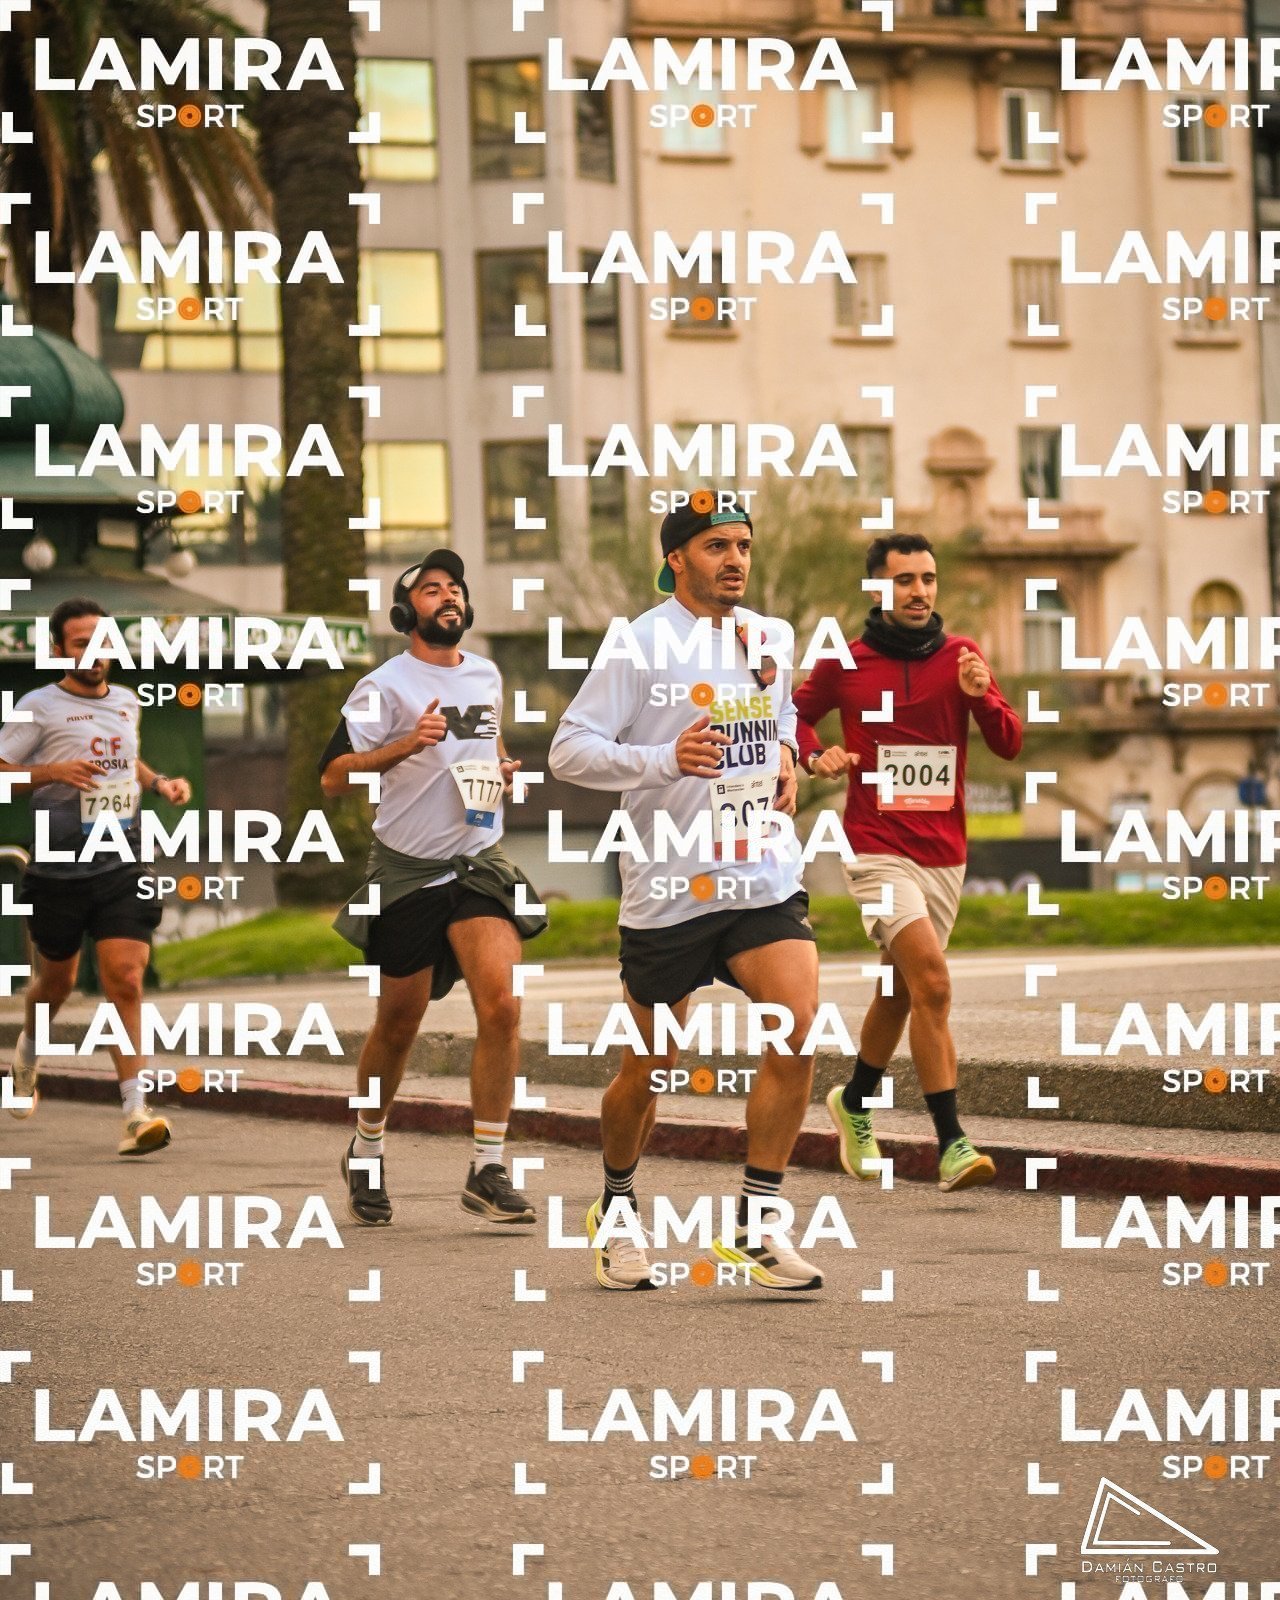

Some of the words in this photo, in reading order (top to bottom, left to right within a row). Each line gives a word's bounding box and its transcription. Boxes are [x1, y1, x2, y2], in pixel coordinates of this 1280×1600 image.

[709, 696, 773, 723] SENSE
[885, 764, 950, 787] 2004
[462, 779, 502, 804] 7777
[85, 793, 131, 816] 7264
